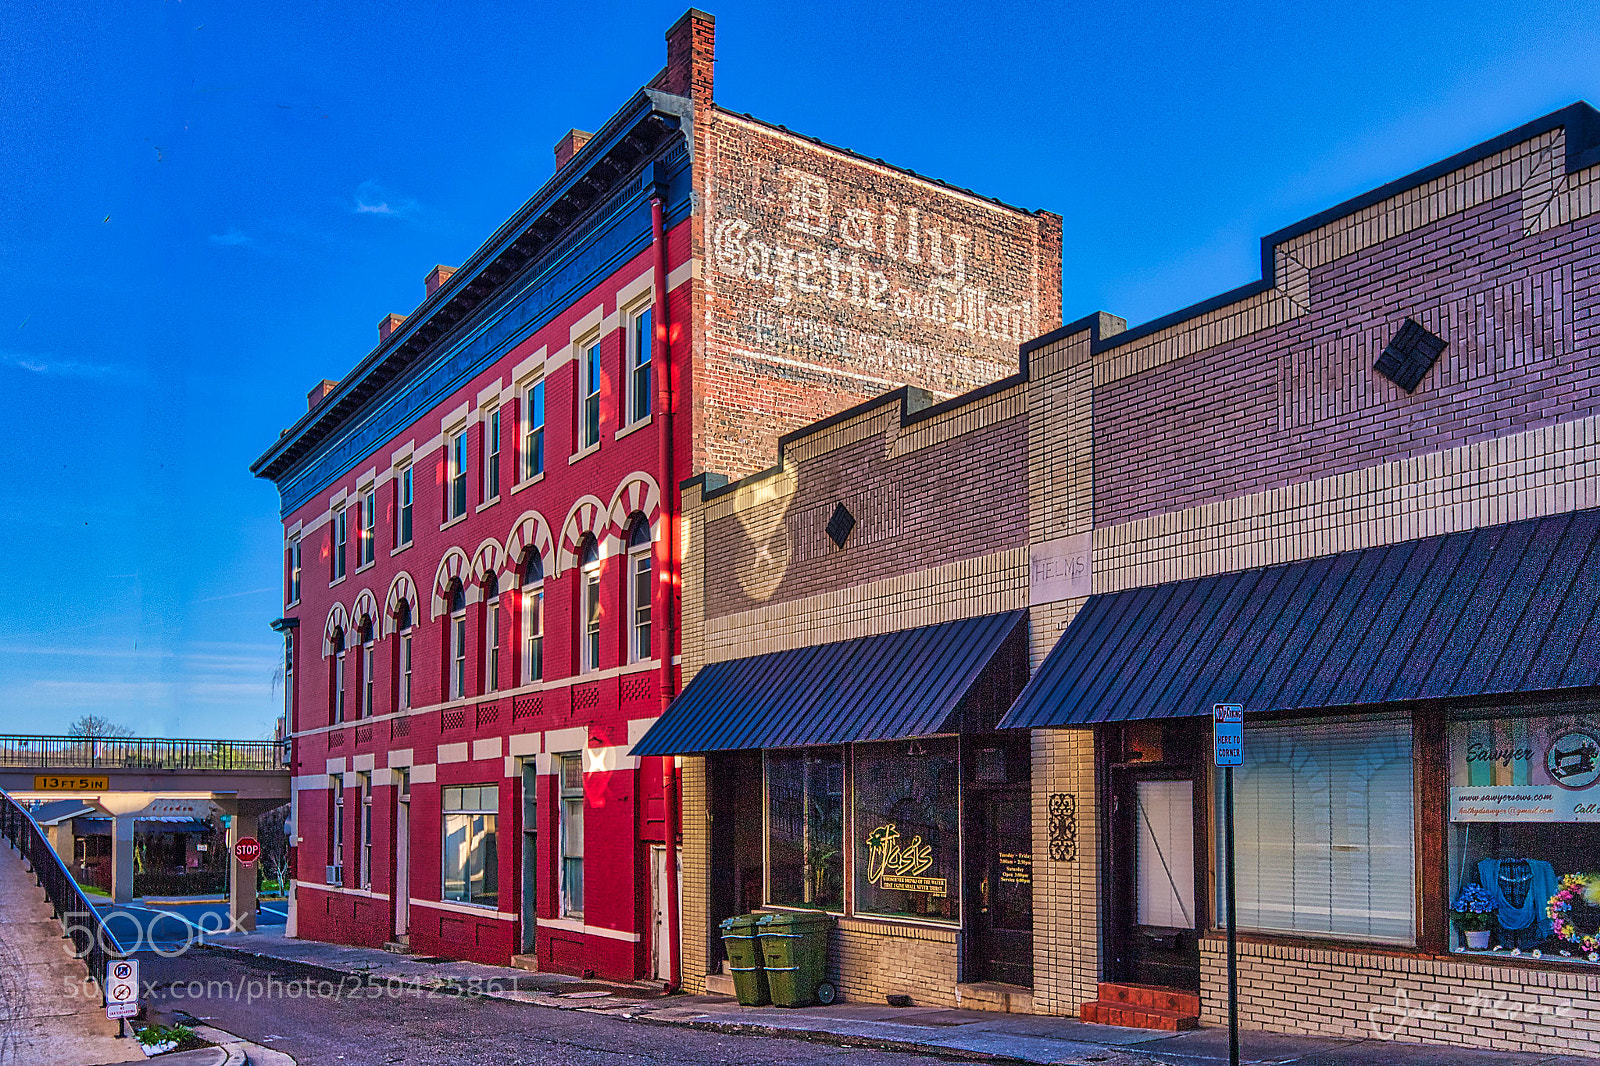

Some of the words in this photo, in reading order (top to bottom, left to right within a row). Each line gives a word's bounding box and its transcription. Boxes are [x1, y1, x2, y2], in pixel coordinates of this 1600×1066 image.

[780, 166, 972, 294] Daily
[714, 217, 889, 311] Gazette
[1035, 556, 1085, 582] HELMS
[1217, 735, 1232, 745] HERE
[1233, 735, 1241, 745] TO
[1218, 748, 1240, 757] CORNER
[1465, 742, 1535, 767] Sawyer
[1458, 793, 1553, 804] www.sawyersews.com
[1573, 803, 1596, 814] Call
[236, 845, 259, 855] STOP
[866, 824, 934, 885] Oasis
